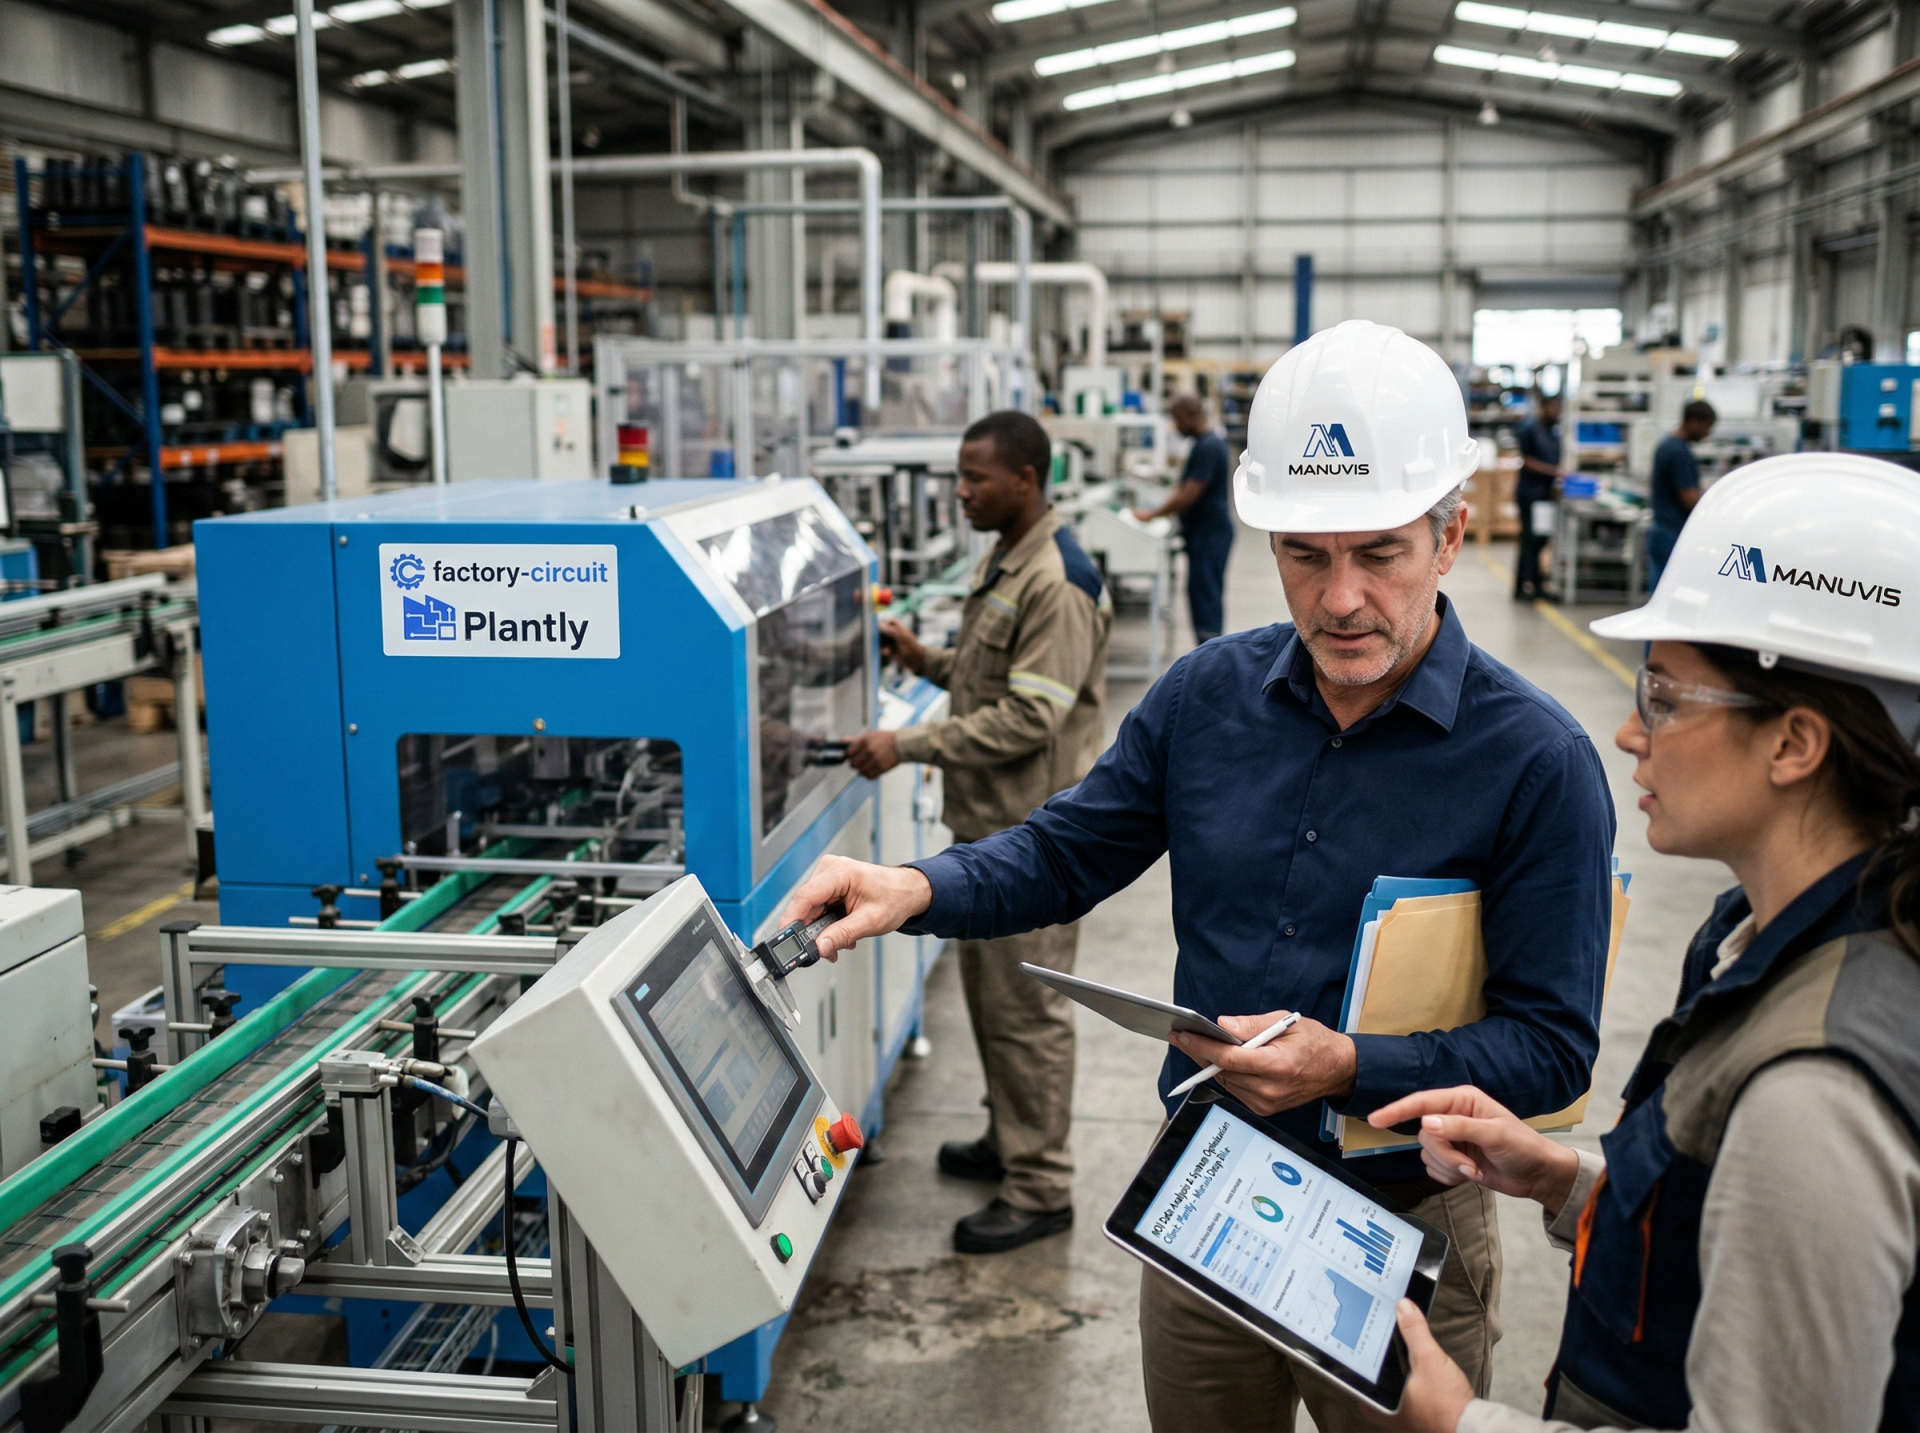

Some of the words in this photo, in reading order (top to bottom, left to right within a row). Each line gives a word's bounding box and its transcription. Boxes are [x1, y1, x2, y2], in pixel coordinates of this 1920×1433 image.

[1289, 464, 1370, 475] MANUVIS
[433, 560, 608, 588] factory-circuit
[1772, 564, 1901, 607] MANUVIS
[464, 611, 589, 651] Plantly
